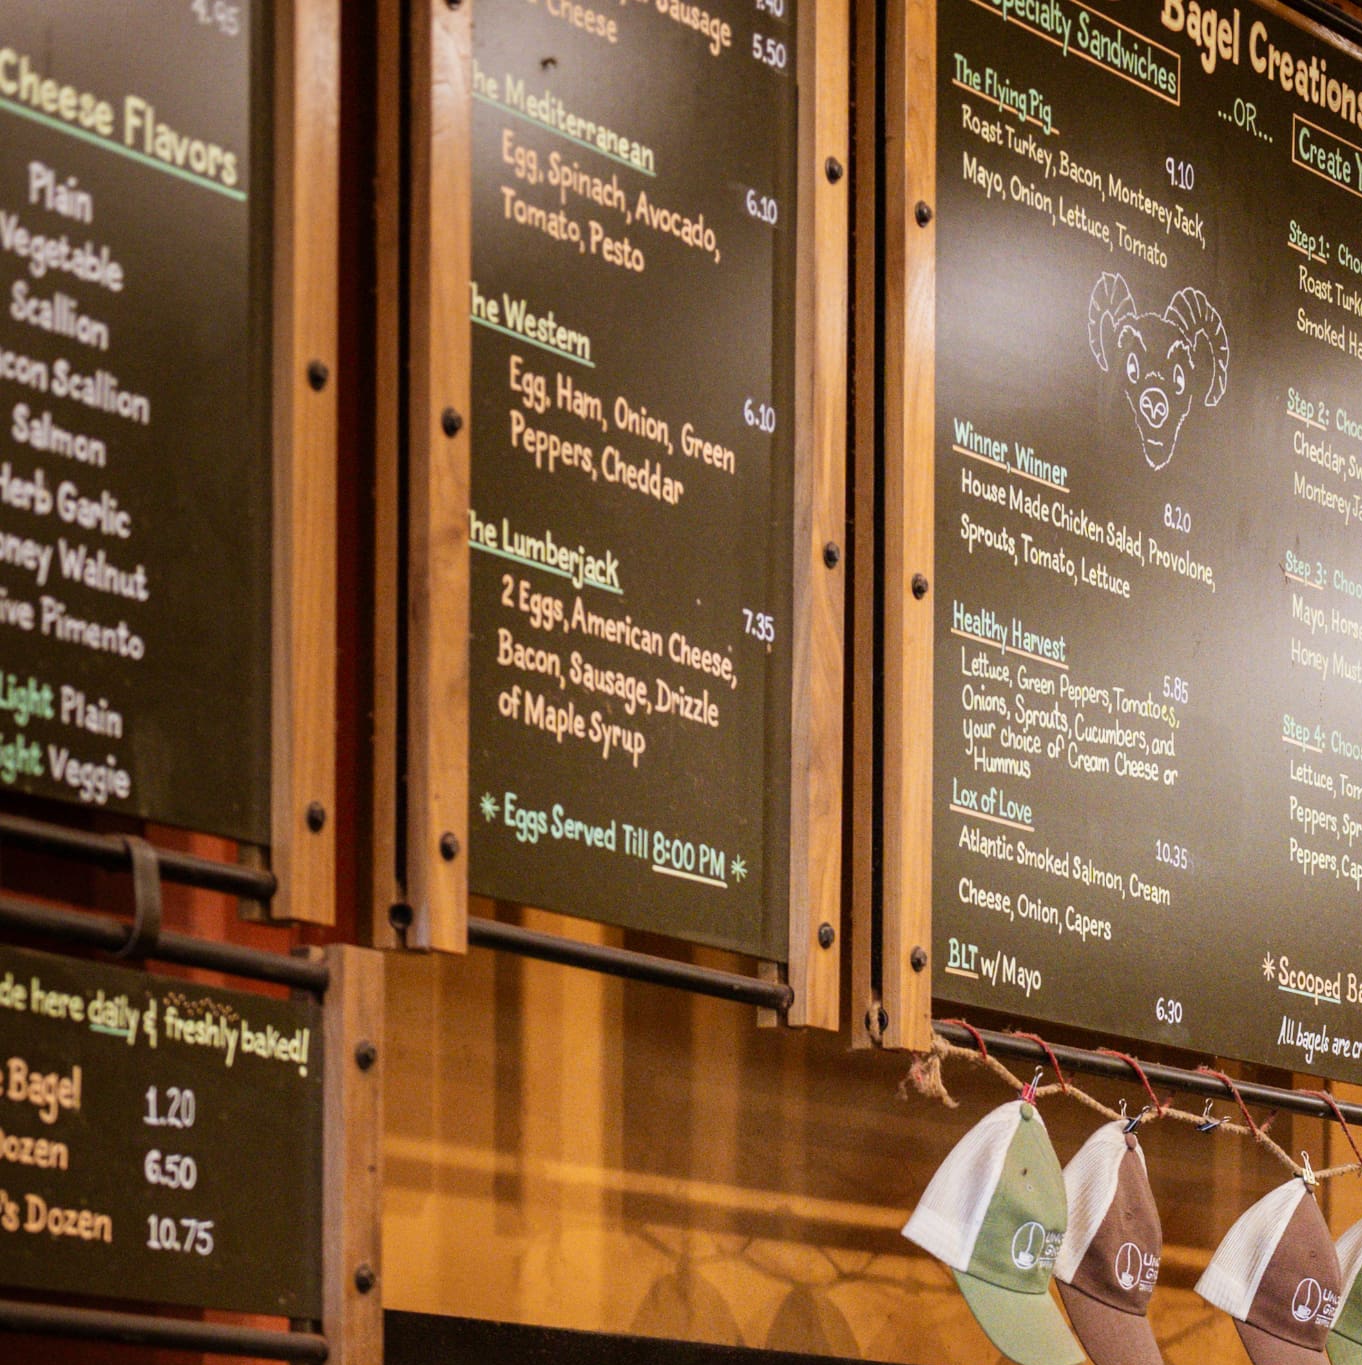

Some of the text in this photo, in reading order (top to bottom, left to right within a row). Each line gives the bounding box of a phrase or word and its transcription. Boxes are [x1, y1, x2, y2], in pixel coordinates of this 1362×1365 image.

[752, 32, 787, 68] 5.50
[1077, 11, 1177, 95] Sandwiches
[1161, 0, 1240, 75] Bagel
[0, 48, 237, 185] Cheese Flavors
[506, 73, 655, 172] Mediterranean
[954, 52, 1051, 135] The Flying Pig
[962, 104, 1205, 250] Roast Turkey, Bacon, Monterey Jack,
[1166, 157, 1194, 190] 9.10
[1299, 127, 1350, 183] Create
[28, 161, 93, 223] Plain
[548, 151, 720, 264] Spinach, Avocado,
[747, 189, 778, 225] 6.10
[963, 152, 1167, 268] Mayo, Onion, Lettuce, Tomato
[0, 210, 123, 291] Vegetable
[501, 186, 645, 273] Tomato, Pesto
[1289, 220, 1316, 260] Step
[10, 280, 109, 350] Scallion
[503, 294, 590, 359] Western
[51, 358, 150, 425] Scallion
[557, 373, 735, 474] Ham, Onion, Green
[744, 398, 775, 433] 6.10
[12, 403, 106, 468] Salmon
[510, 410, 683, 505] Peppers, Cheddar
[954, 417, 1067, 486] Winner, Winner
[57, 480, 131, 538] Garlic
[962, 469, 1215, 592] House Made Chicken Salad, Provolone,
[1164, 503, 1191, 533] 8.20
[58, 537, 149, 602] Walnut
[502, 518, 619, 589] Lumberjack
[40, 595, 145, 660] Pimento
[502, 574, 737, 689] 2 Eggs, American Cheese,
[743, 608, 774, 642] 7.35
[954, 600, 1066, 661] Healthy Harvest
[0, 669, 123, 739] Light Plain
[497, 629, 719, 727] Bacon, Sausage, Drizzle
[962, 646, 1180, 729] Lettuce, Green Peppers, Tomatoes,
[1163, 675, 1188, 703] 5.85
[499, 685, 645, 768] of Maple Syrup
[1075, 714, 1175, 756] Cucumbers, and
[48, 744, 131, 805] Veggie
[974, 747, 1031, 779] Hummus
[952, 777, 1032, 824] Lox of Love
[505, 792, 725, 880] Eggs Served Till 8:00 PM
[959, 825, 1170, 906] Atlantic Smoked Salmon, Cream
[1156, 839, 1188, 869] 10.35
[959, 878, 1111, 941] Cheese, Onion, Capers
[948, 938, 978, 971] BLT
[1002, 955, 1041, 997] Mayo
[1278, 956, 1341, 1005] Scooped
[30, 977, 310, 1078] here daily freshly baked!
[1156, 997, 1182, 1024] 6.30
[1278, 1015, 1294, 1045] All
[1296, 1021, 1329, 1064] bagels
[1331, 1039, 1350, 1057] are
[7, 1056, 196, 1128] Bagel 1.20
[144, 1150, 197, 1190] 6.50
[24, 1193, 214, 1256] Dozen 10.75
